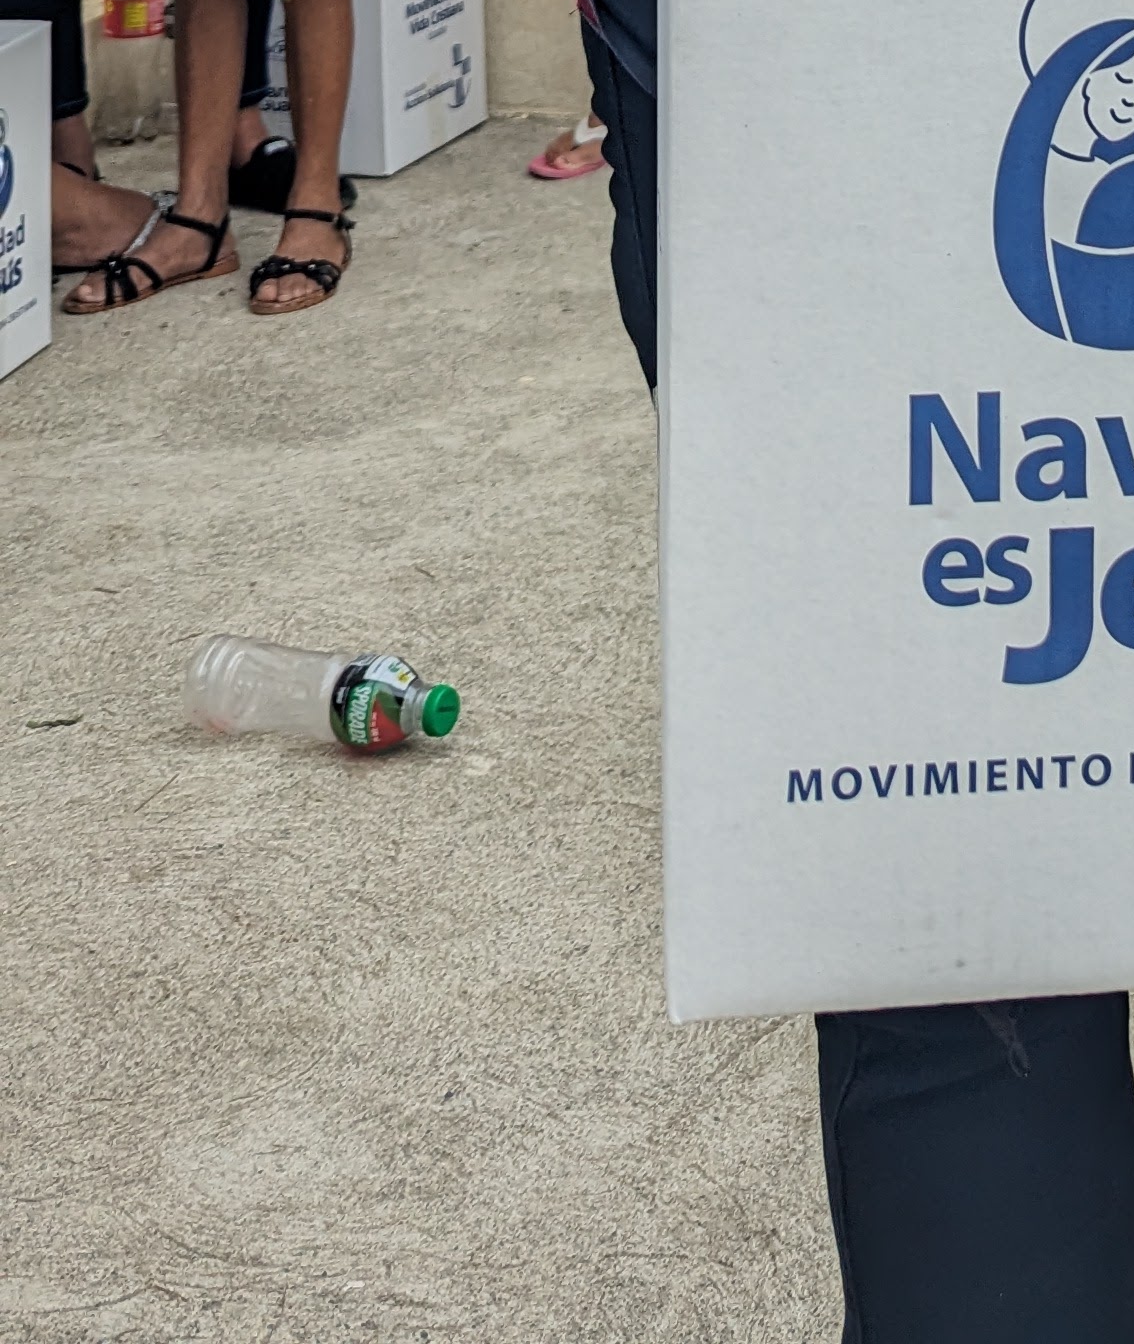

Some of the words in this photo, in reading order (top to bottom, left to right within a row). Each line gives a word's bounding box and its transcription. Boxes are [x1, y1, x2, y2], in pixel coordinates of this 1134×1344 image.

[921, 535, 1033, 608] es
[347, 685, 373, 744] SPORADE
[786, 751, 1113, 804] MOVIMIENTO
